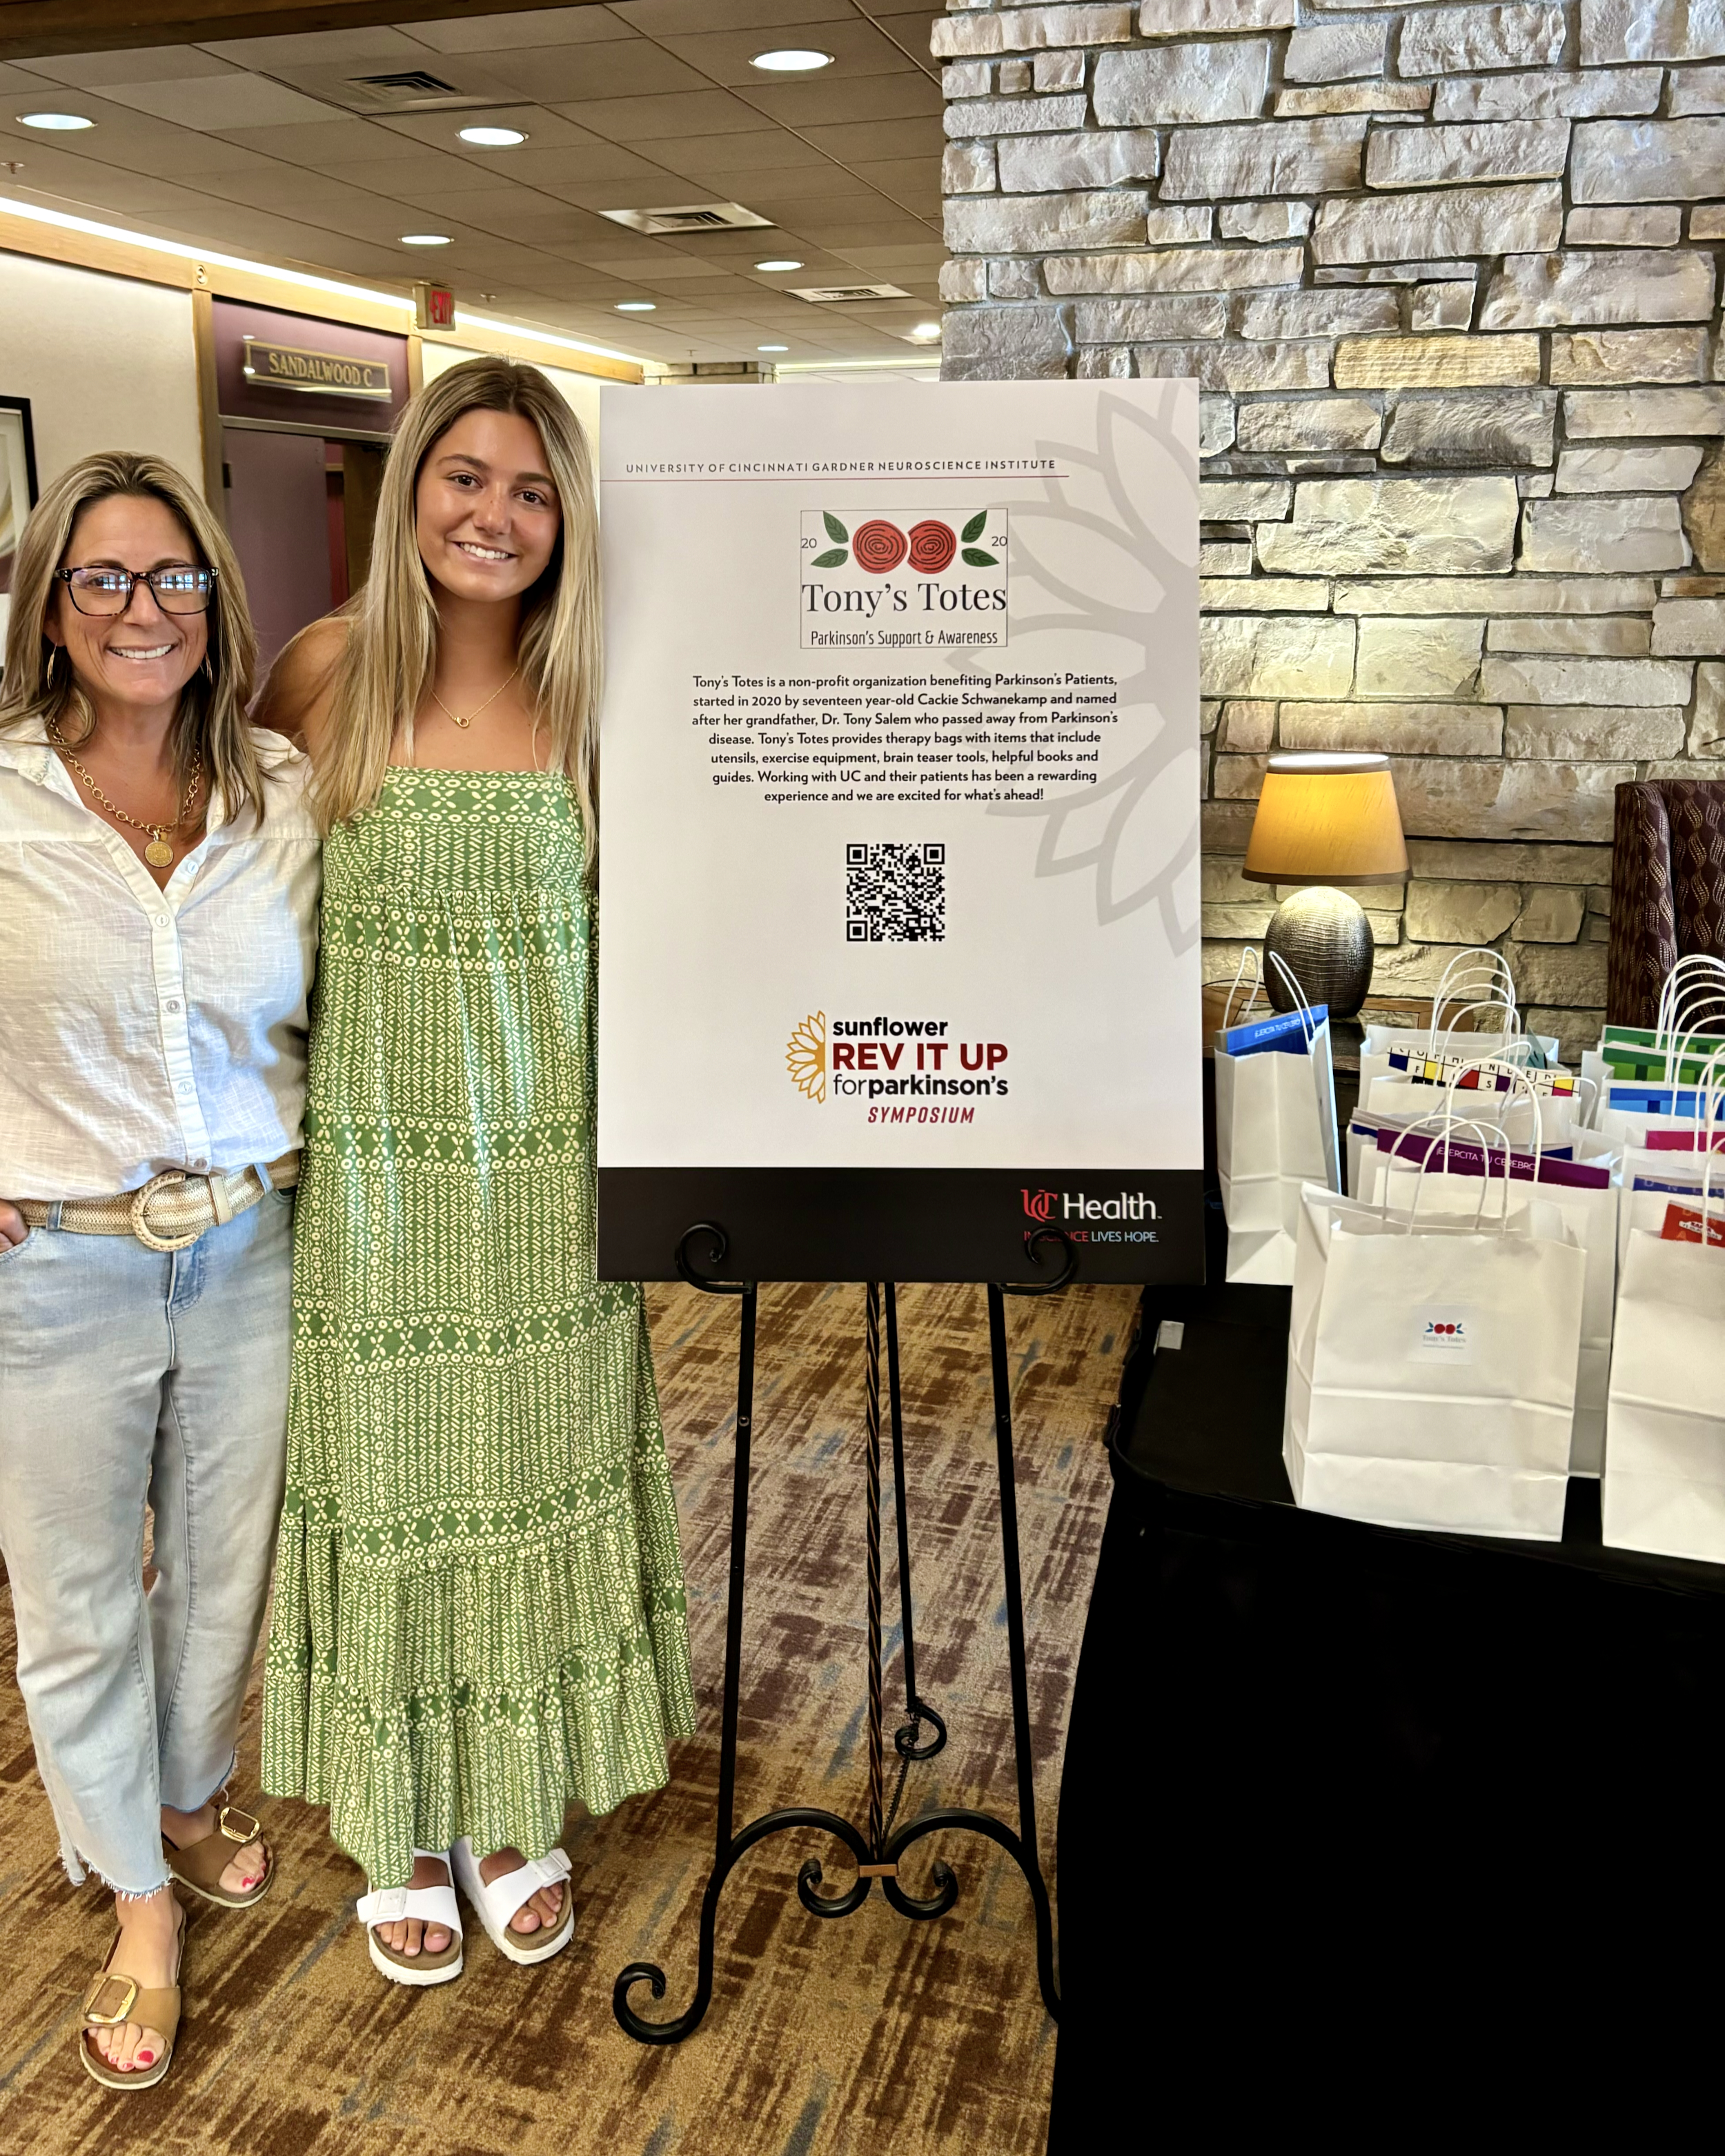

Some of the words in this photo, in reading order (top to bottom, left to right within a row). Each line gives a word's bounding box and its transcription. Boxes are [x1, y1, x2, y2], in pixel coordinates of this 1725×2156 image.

[268, 353, 361, 386] SANDALWOOD
[364, 368, 373, 387] C
[626, 463, 704, 473] UNIVERSITY
[708, 463, 725, 473] OF
[729, 462, 808, 473] CINCINNATI
[811, 462, 874, 472] GARDNER
[878, 460, 981, 471] NEUROSCIENCE
[985, 459, 1055, 470] INSTITUTE
[801, 538, 817, 548] 20
[992, 536, 1007, 546] 20
[802, 583, 907, 619] Tony's
[917, 582, 1005, 611] Totes
[811, 630, 874, 646] Parkinson's
[878, 630, 923, 648] Support
[925, 630, 934, 644] &
[938, 629, 998, 644] Awareness
[692, 675, 729, 691] Tony's
[731, 675, 764, 687] Totes
[767, 676, 776, 687] is
[778, 679, 786, 687] a
[788, 674, 850, 690] non-profit
[852, 675, 927, 690] organization
[929, 673, 992, 689] benefiting
[995, 672, 1062, 686] Parkinson's
[1065, 672, 1118, 686] Patients,
[693, 694, 735, 706] started
[738, 695, 749, 706] in
[751, 695, 782, 706] 2020
[785, 693, 800, 709] by
[802, 696, 862, 706] seventeen
[865, 693, 914, 709] year-old
[917, 693, 959, 706] Cackie
[961, 692, 1047, 708] Schwanekamp
[1049, 691, 1073, 704] and
[1076, 691, 1117, 704] named
[691, 713, 721, 726] after
[723, 713, 743, 726] her
[745, 713, 818, 729] grandfather,
[822, 713, 840, 725] Dr.
[842, 712, 872, 729] Tony
[874, 712, 911, 725] Salem
[914, 711, 939, 724] who
[942, 711, 983, 728] passed
[985, 715, 1016, 727] away
[1018, 711, 1048, 724] from
[1051, 710, 1118, 724] Parkinson's
[708, 732, 755, 744] disease.
[757, 731, 794, 748] Tony's
[796, 731, 829, 744] Totes
[831, 731, 883, 747] provides
[885, 731, 931, 747] therapy
[934, 731, 963, 746] bags
[965, 731, 991, 744] with
[994, 732, 1027, 743] items
[1029, 730, 1055, 743] that
[1057, 730, 1101, 743] include
[711, 751, 759, 765] utensils,
[762, 752, 810, 764] exercise
[812, 752, 880, 767] equipment,
[883, 750, 914, 763] brain
[916, 753, 954, 763] teaser
[956, 750, 989, 764] tools,
[992, 749, 1034, 765] helpful
[1036, 749, 1074, 762] books
[1075, 749, 1098, 762] and
[712, 770, 754, 786] guides.
[757, 770, 809, 786] Working
[811, 769, 837, 782] with
[840, 769, 861, 782] UC
[863, 769, 886, 782] and
[889, 769, 918, 782] their
[920, 770, 969, 785] patients
[971, 769, 992, 782] has
[994, 769, 1025, 782] been
[1027, 773, 1034, 781] a
[1037, 769, 1097, 784] rewarding
[764, 790, 829, 804] experience
[831, 789, 854, 802] and
[856, 793, 874, 801] we
[876, 793, 895, 801] are
[897, 788, 941, 801] excited
[943, 788, 962, 801] for
[964, 788, 1001, 801] what's
[1003, 787, 1044, 800] ahead!
[832, 1016, 948, 1036] sunflower
[833, 1042, 905, 1070] REV
[917, 1042, 948, 1070] IT
[960, 1042, 1008, 1071] UP
[867, 1107, 975, 1124] SYMPOSIUM
[1436, 1147, 1478, 1161] ¡EERCITA
[1021, 1189, 1058, 1223] UC
[1063, 1192, 1156, 1220] Health
[1091, 1231, 1122, 1242] LIVES
[1124, 1231, 1160, 1243] HOPE.
